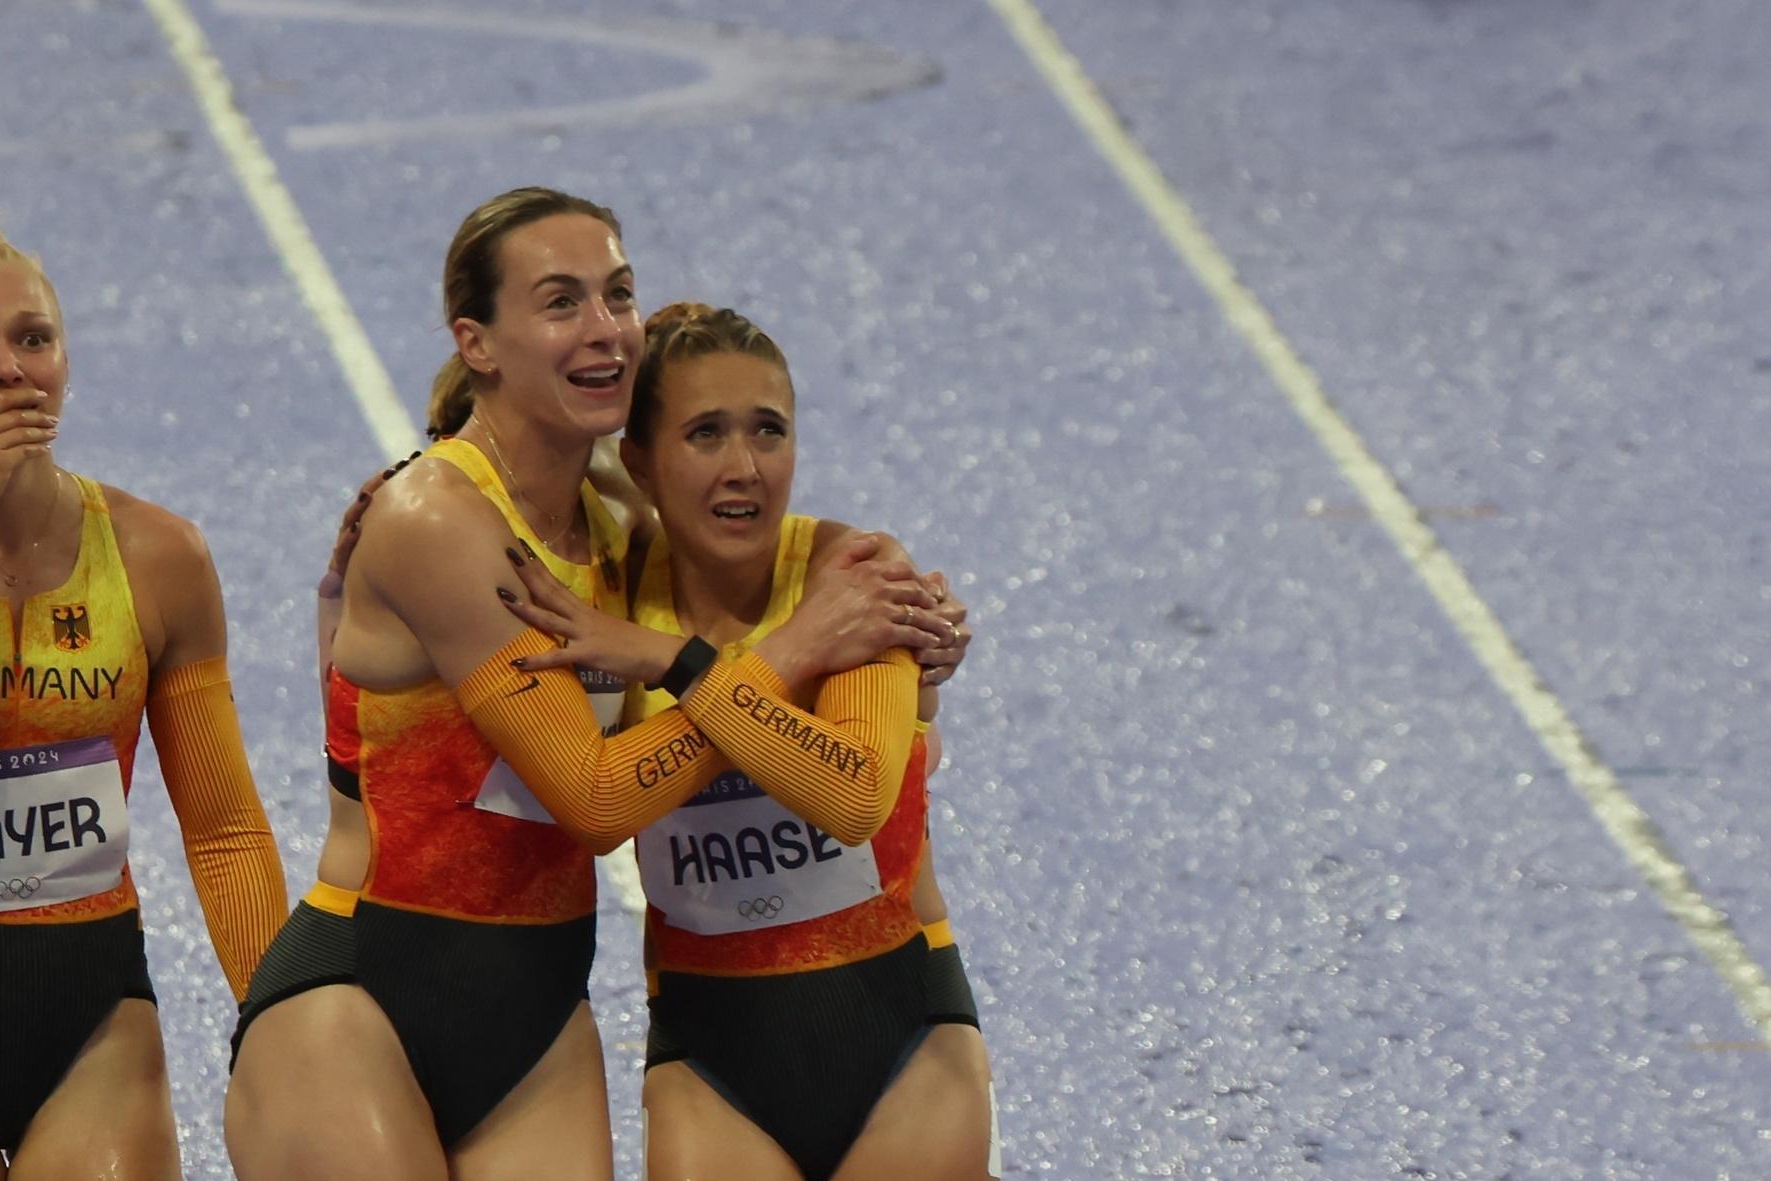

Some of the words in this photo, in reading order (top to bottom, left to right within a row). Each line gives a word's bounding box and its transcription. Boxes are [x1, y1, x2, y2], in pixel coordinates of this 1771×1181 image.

[9, 750, 59, 770] 2024
[635, 732, 706, 790] GERM
[732, 683, 868, 780] GERMANY
[669, 819, 844, 886] HAASE
